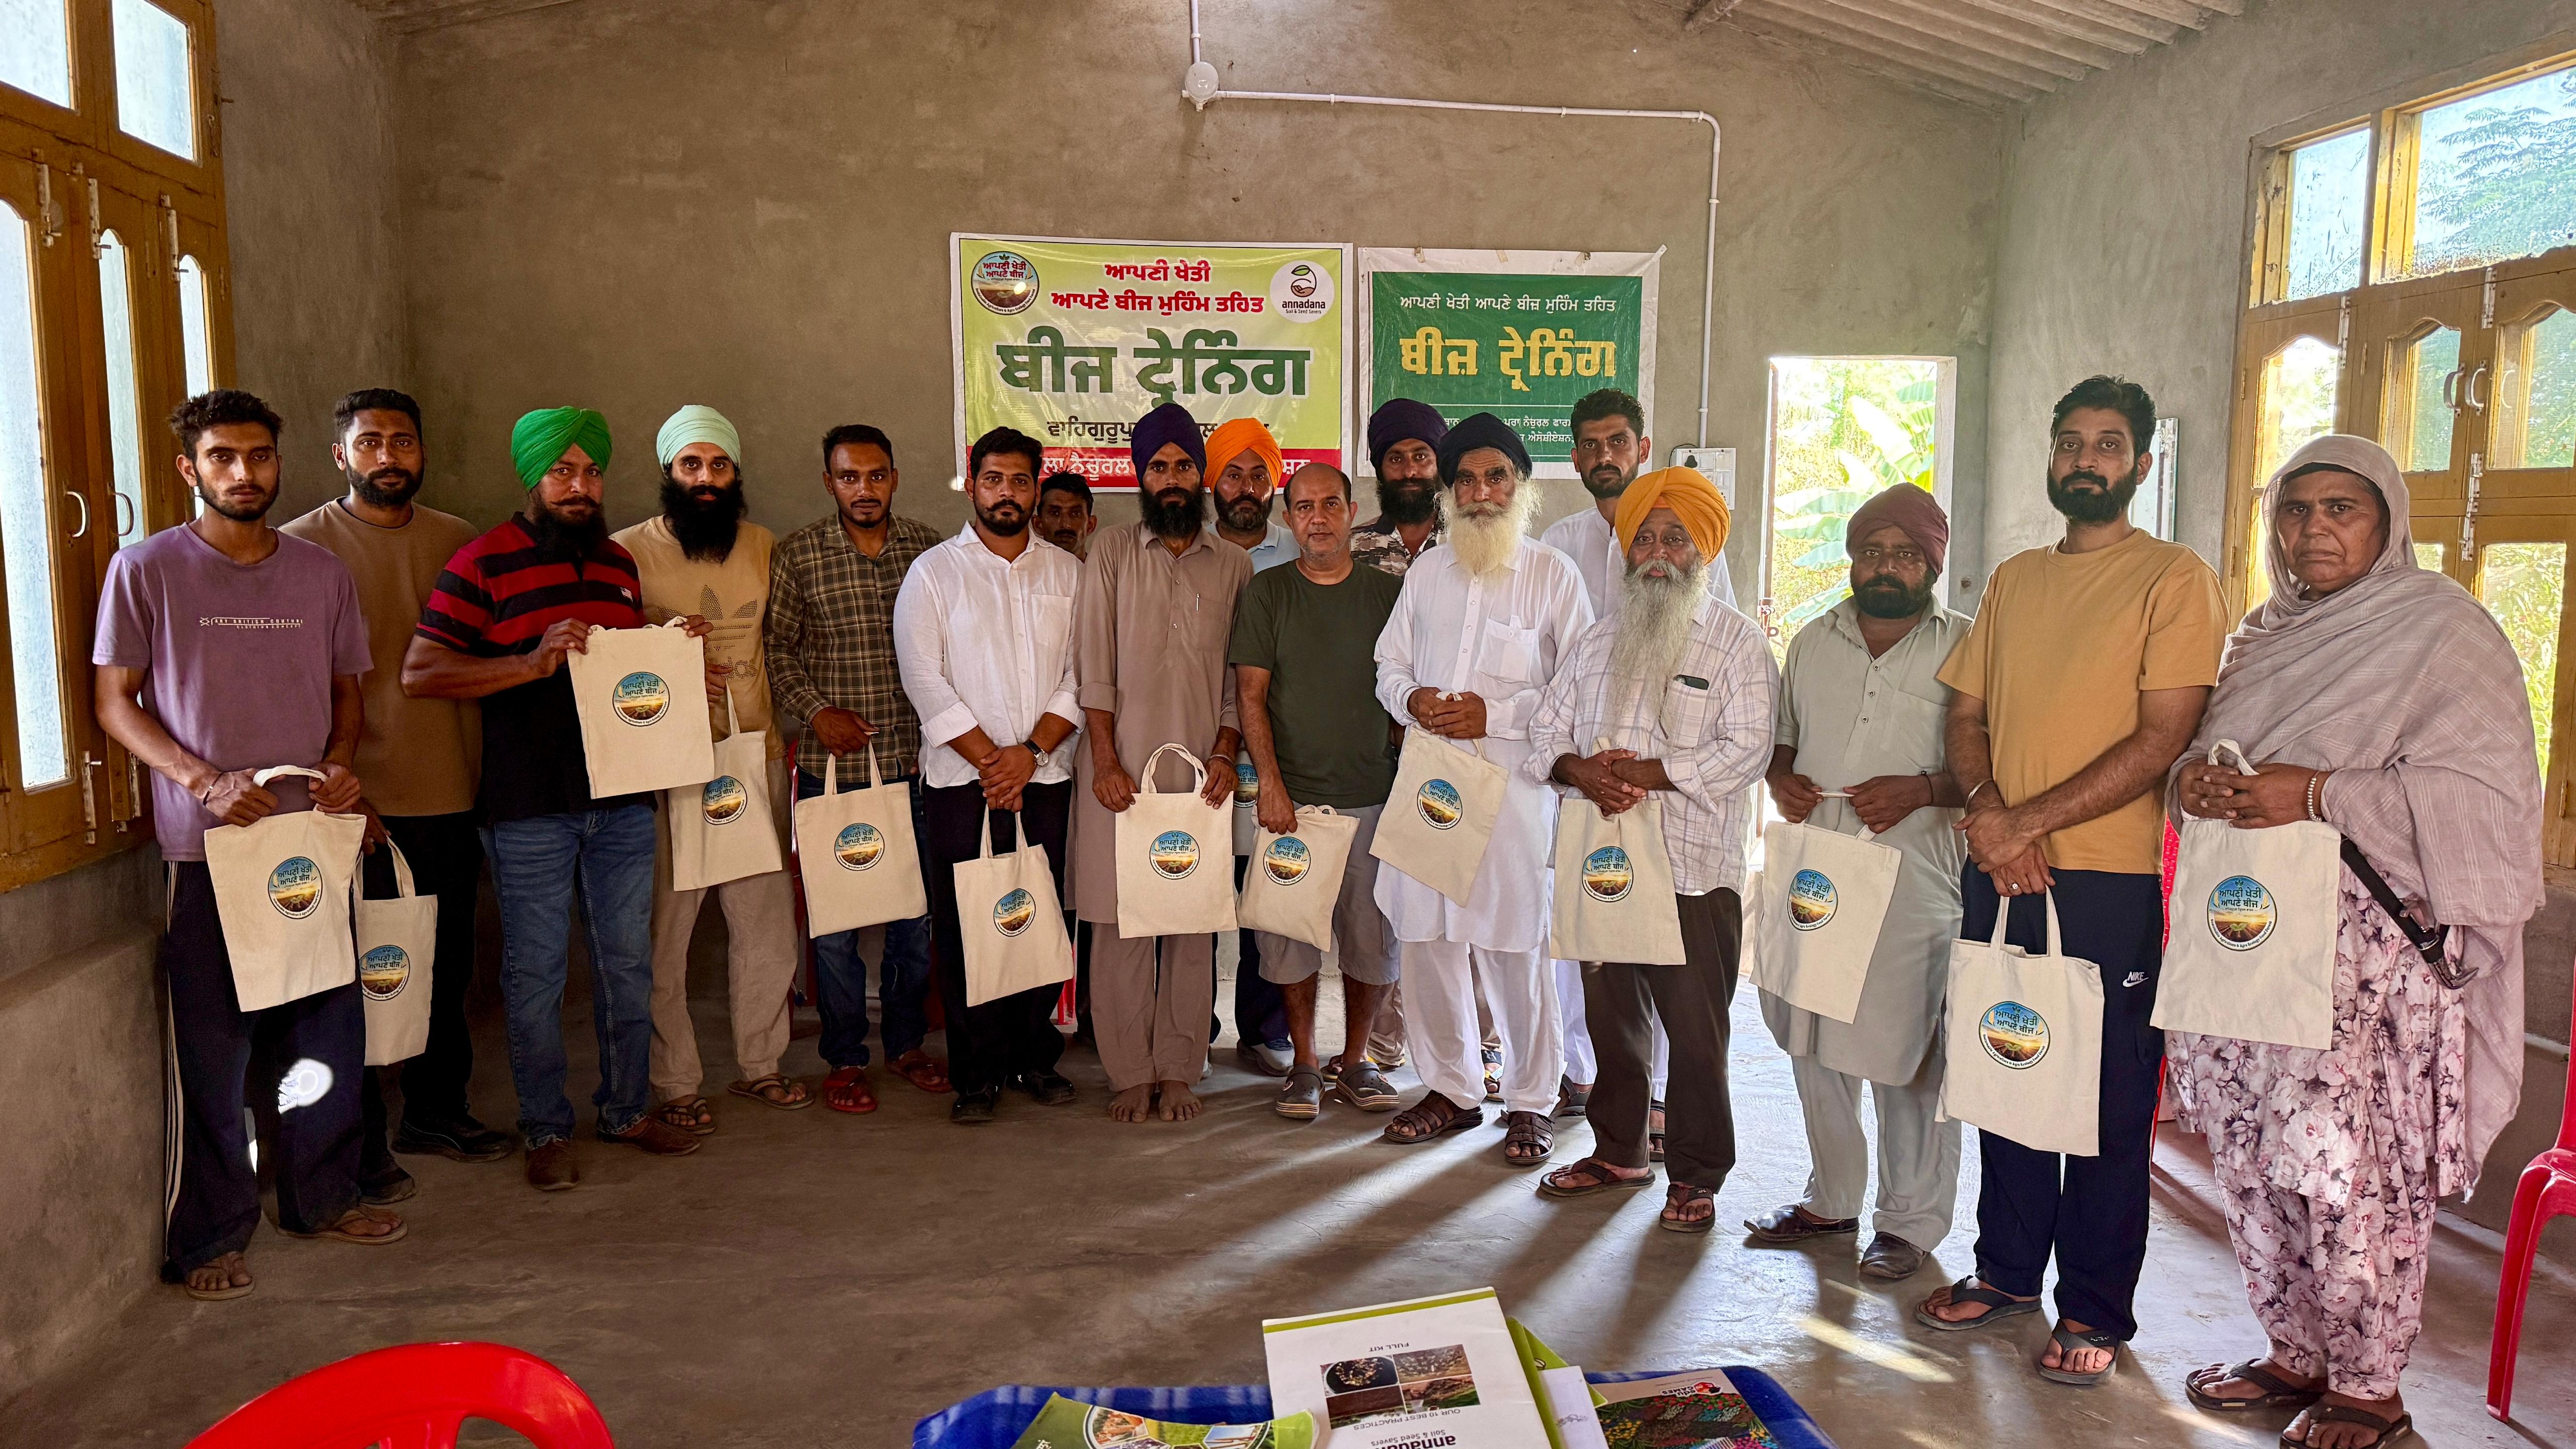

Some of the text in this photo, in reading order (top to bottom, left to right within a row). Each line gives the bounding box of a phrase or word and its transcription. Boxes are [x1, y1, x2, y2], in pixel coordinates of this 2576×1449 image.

[983, 261, 1026, 270] ਆਪਣੀ ਖੇਤੀ
[1104, 259, 1211, 282] ਆਪਣੀ ਖੇਤੀ
[1009, 270, 1024, 278] ਬੀਜ
[1051, 288, 1264, 315] ਆਪਣੇ ਬੀਜ ਮੁਹਿੰਮ ਤਹਿਤ
[1282, 299, 1325, 309] annadana
[1400, 292, 1617, 313] ਆਪਣੀ ਖੇਤੀ ਆਪਣੇ ਬੀਜ਼ ਮੁਹਿੰਮ ਤਹਿਤ
[1400, 327, 1617, 391] ਬੀਜ਼ ਟ੍ਰੇਨਿੰਗ
[996, 326, 1311, 408] ਬੀਜ ਟ੍ਰੇਨਿੰਗ
[1047, 416, 1138, 444] ਵਾਹਿਗੁਰੂਪੁ
[2219, 887, 2262, 898] ਆਪਣੀ ਖੇਤੀ
[2221, 898, 2258, 908] ਆਪਣੇ ਬੀਜ
[2127, 972, 2144, 981] NIKE
[1995, 1010, 2037, 1025] ਆਪਣੀ ਖੇਤੀ
[1997, 1019, 2017, 1030] ਆਪਣੇ
[2019, 1025, 2034, 1034] ਬੀਜ
[1662, 1386, 1694, 1395] GAMES
[1405, 1413, 1427, 1421] BEST
[1353, 1417, 1403, 1430] PRACTICES
[1431, 1429, 1445, 1437] Soil
[1371, 1437, 1398, 1446] Savers
[1375, 1435, 1456, 1449] anna
